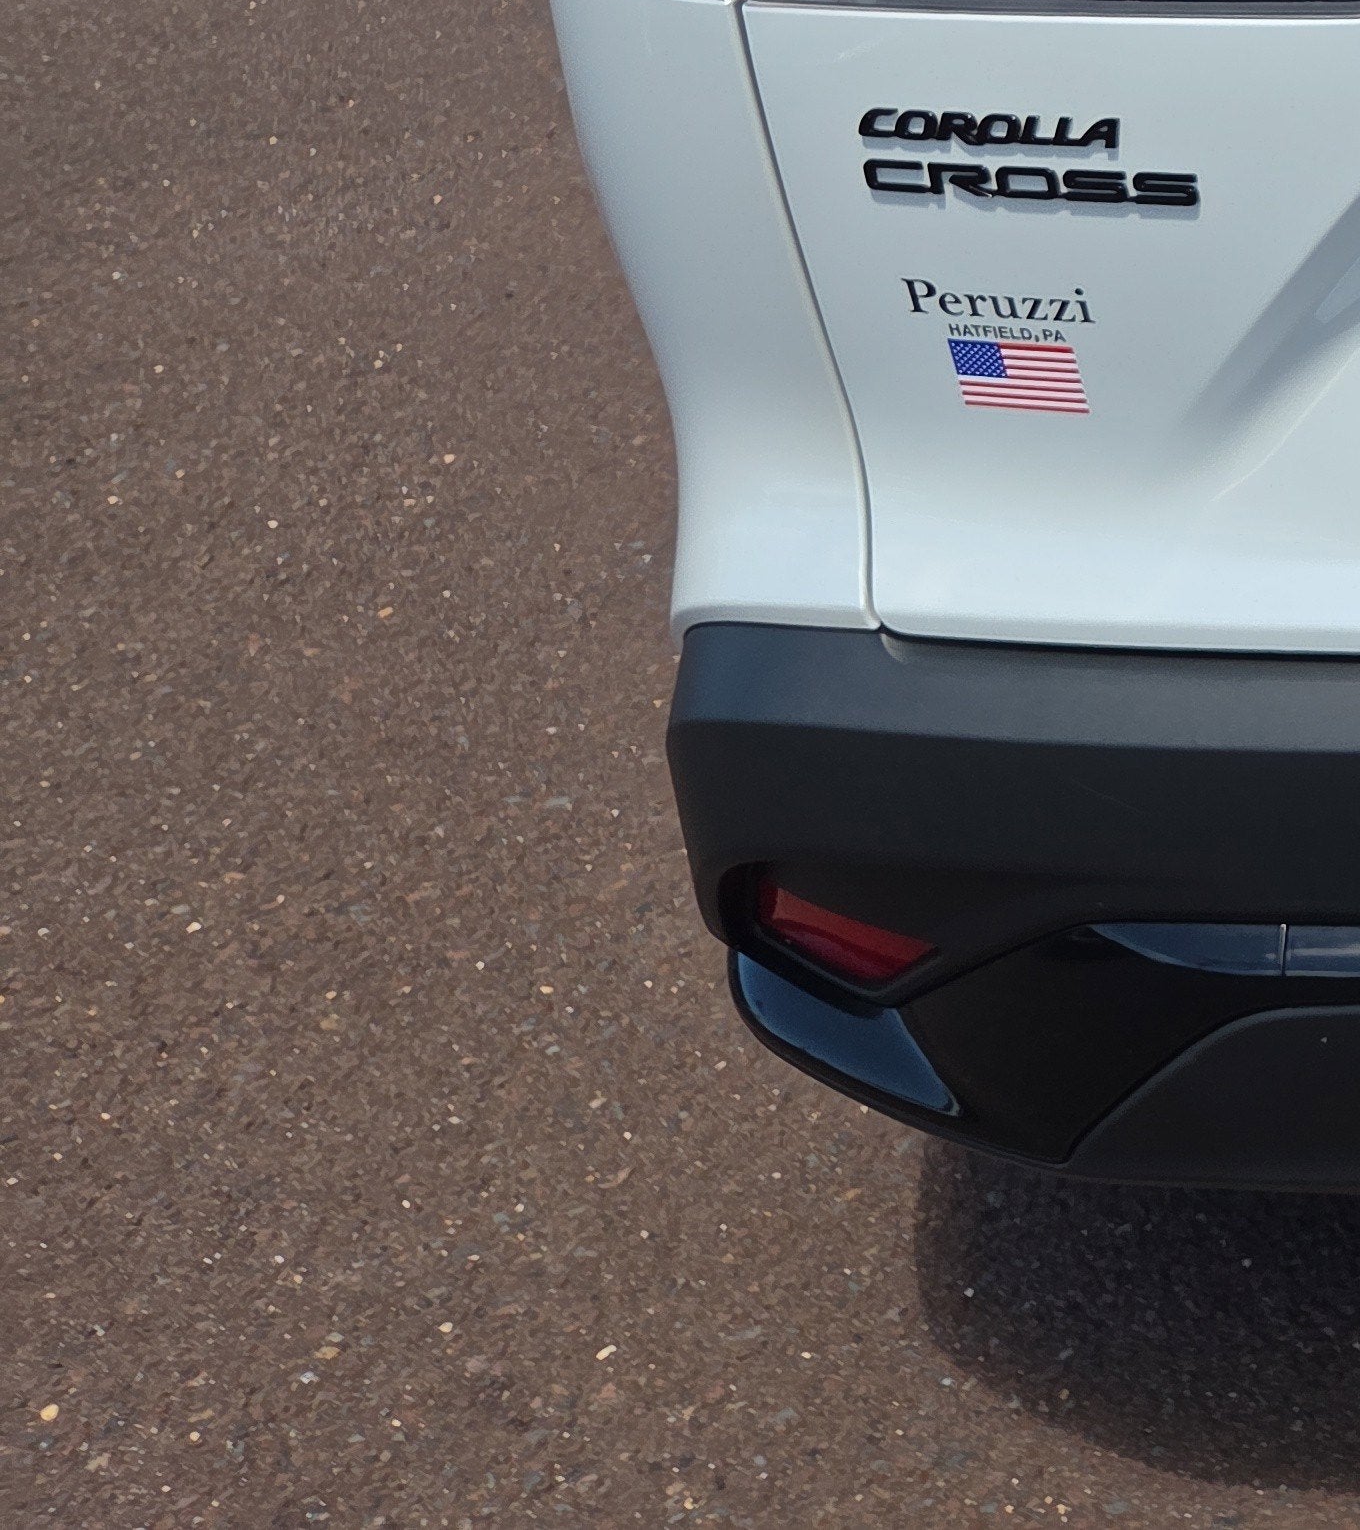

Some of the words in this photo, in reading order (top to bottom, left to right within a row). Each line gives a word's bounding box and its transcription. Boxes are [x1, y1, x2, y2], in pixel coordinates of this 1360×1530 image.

[858, 107, 1120, 149] COROLLA
[862, 158, 1199, 206] CROSS
[901, 277, 1096, 324] Peruzzi
